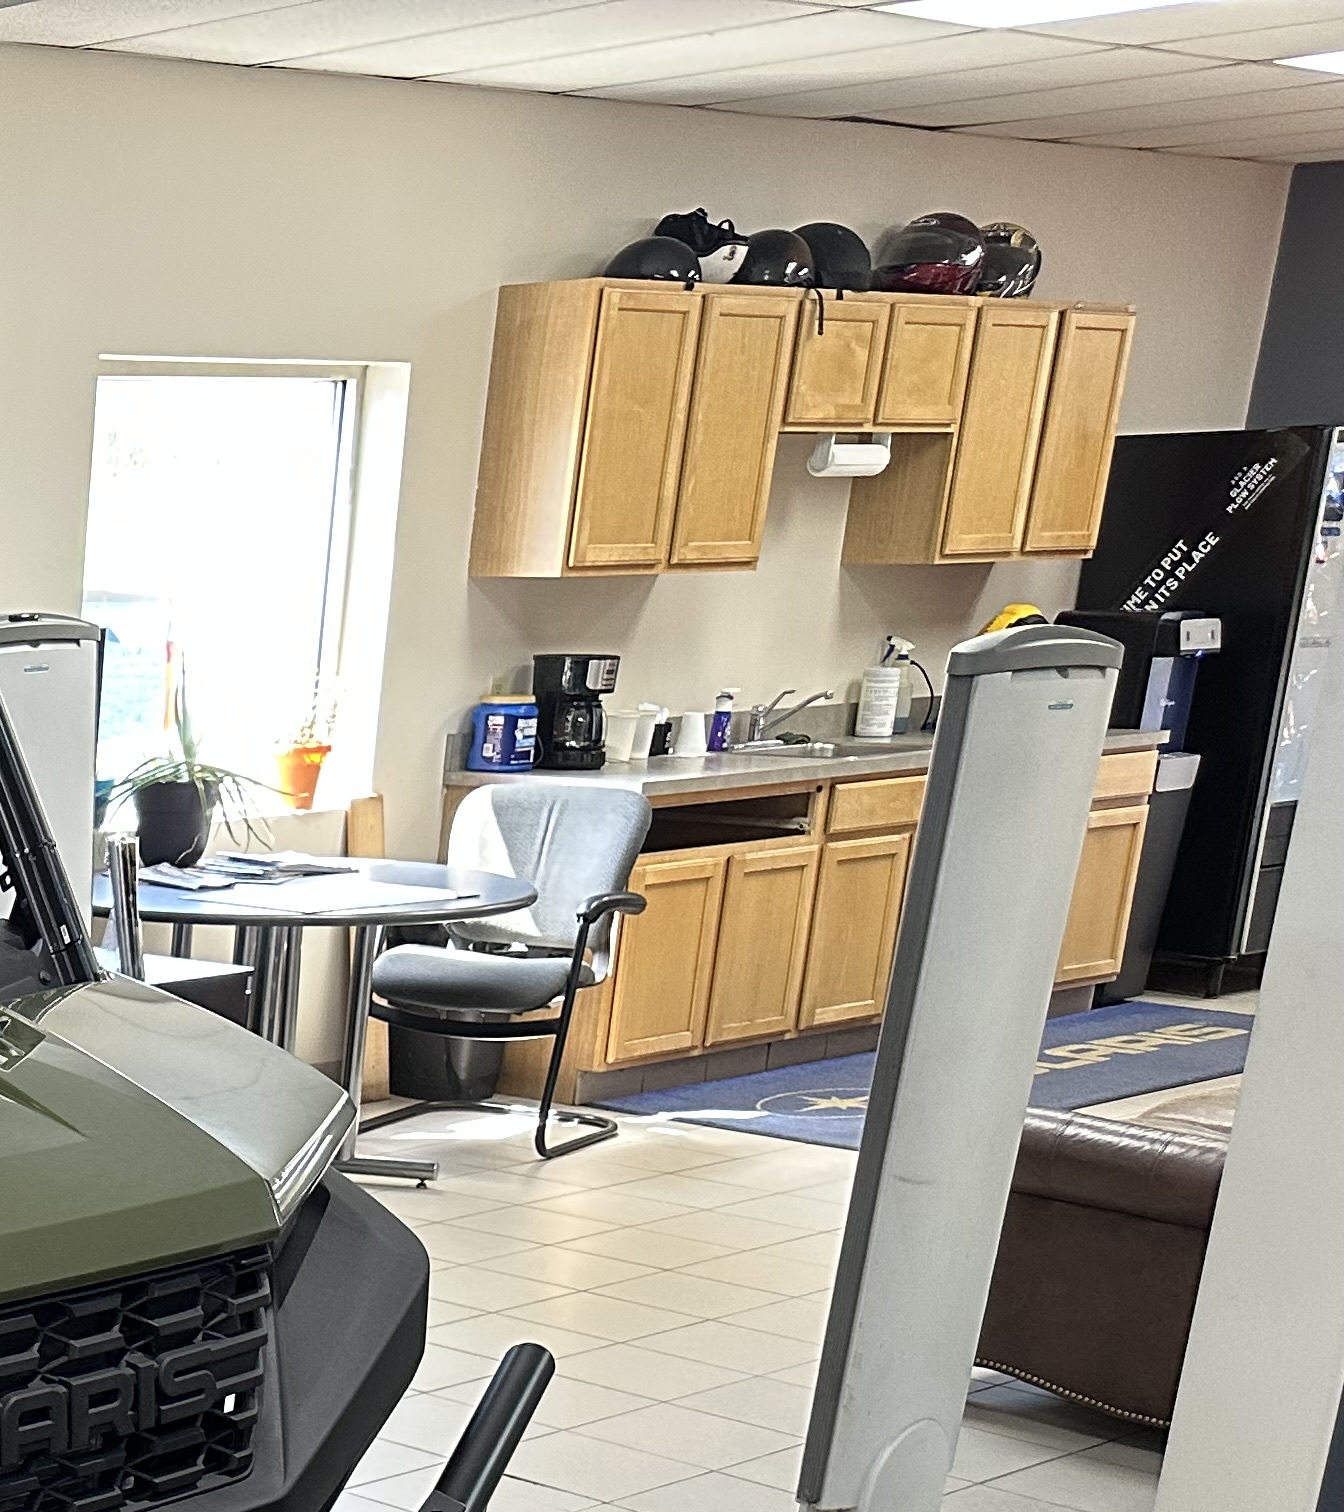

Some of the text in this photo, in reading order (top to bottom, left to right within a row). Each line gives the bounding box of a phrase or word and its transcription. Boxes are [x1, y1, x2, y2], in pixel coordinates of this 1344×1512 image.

[1226, 488, 1249, 514] PLOW
[1247, 457, 1278, 490] SYSTEM
[1229, 462, 1261, 498] GLACIER
[1119, 538, 1189, 612] IME TO PUT
[1153, 577, 1179, 603] ITS
[1174, 531, 1220, 580] PLACE
